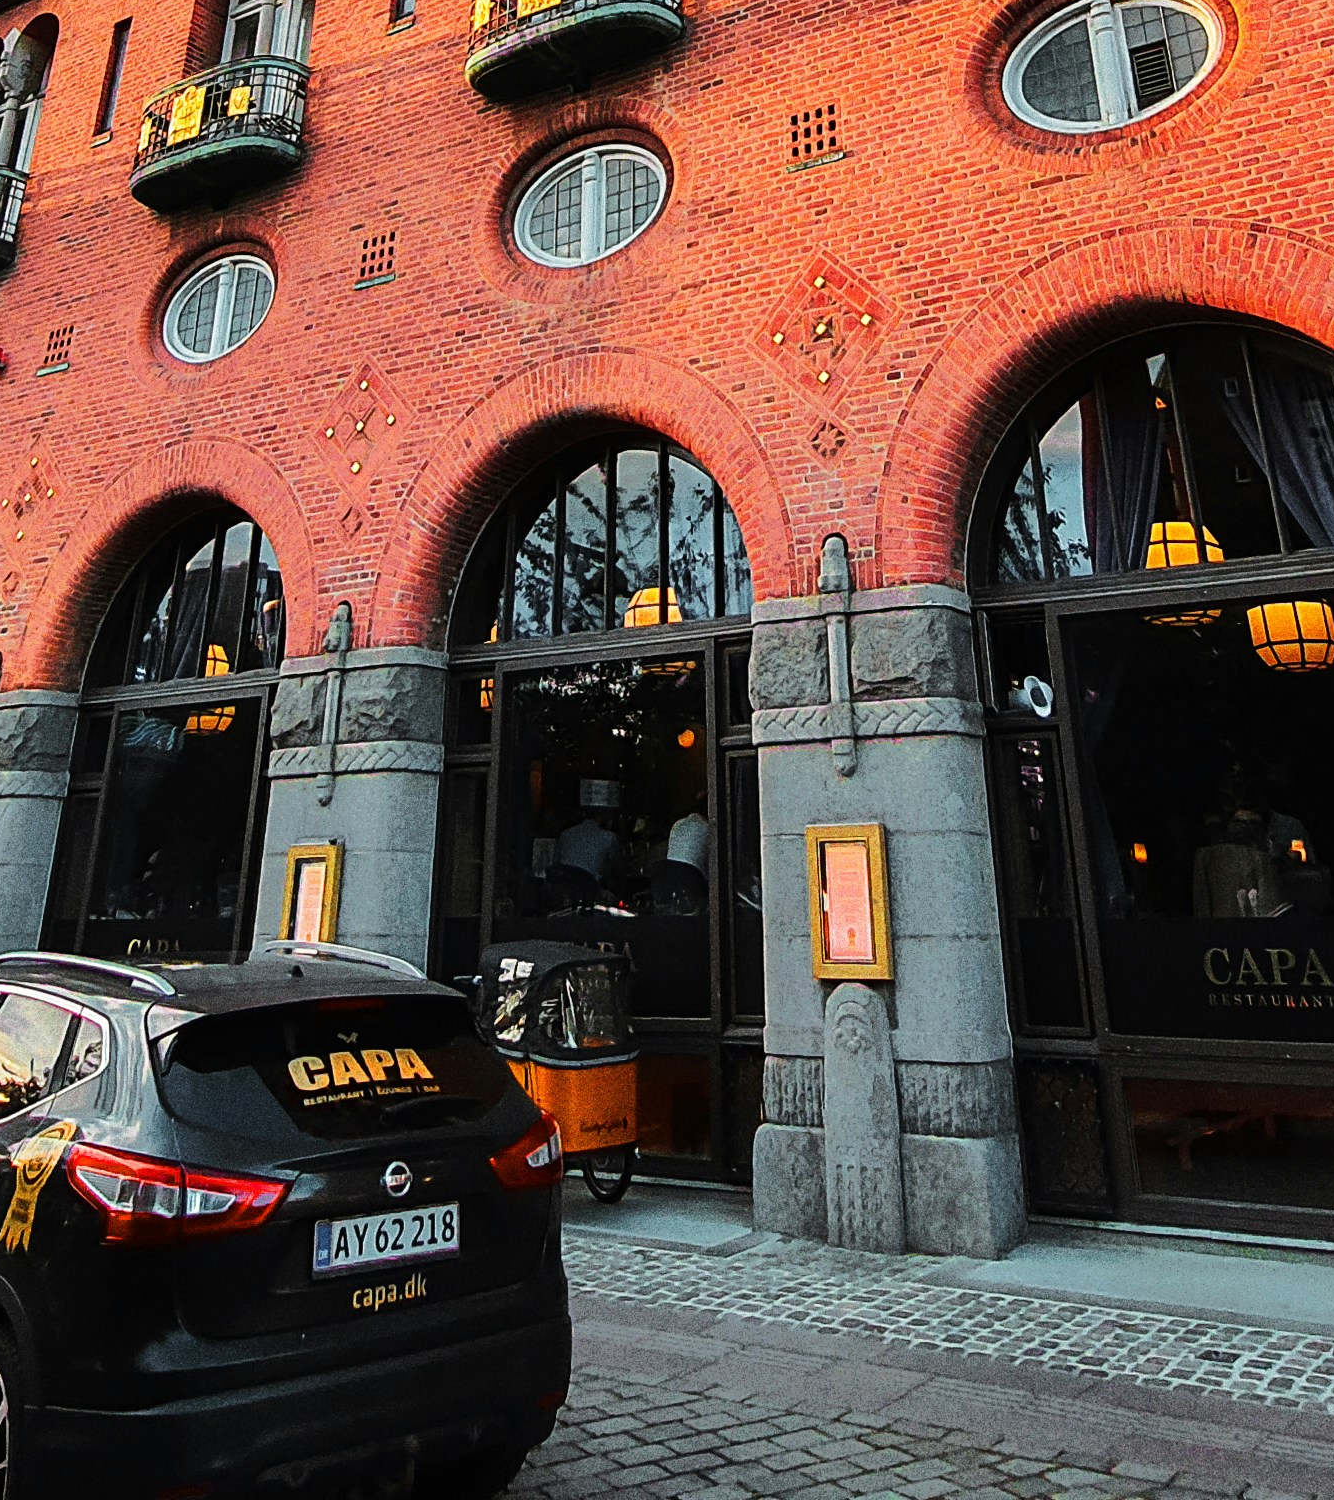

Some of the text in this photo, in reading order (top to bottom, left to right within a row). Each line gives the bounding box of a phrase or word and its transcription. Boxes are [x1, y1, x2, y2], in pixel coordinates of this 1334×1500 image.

[1203, 947, 1334, 987] CAPA
[287, 1048, 434, 1091] CAPA
[303, 1090, 364, 1106] RESTAURANT
[334, 1209, 456, 1260] AY 62 218
[352, 1272, 427, 1312] capa.dk
